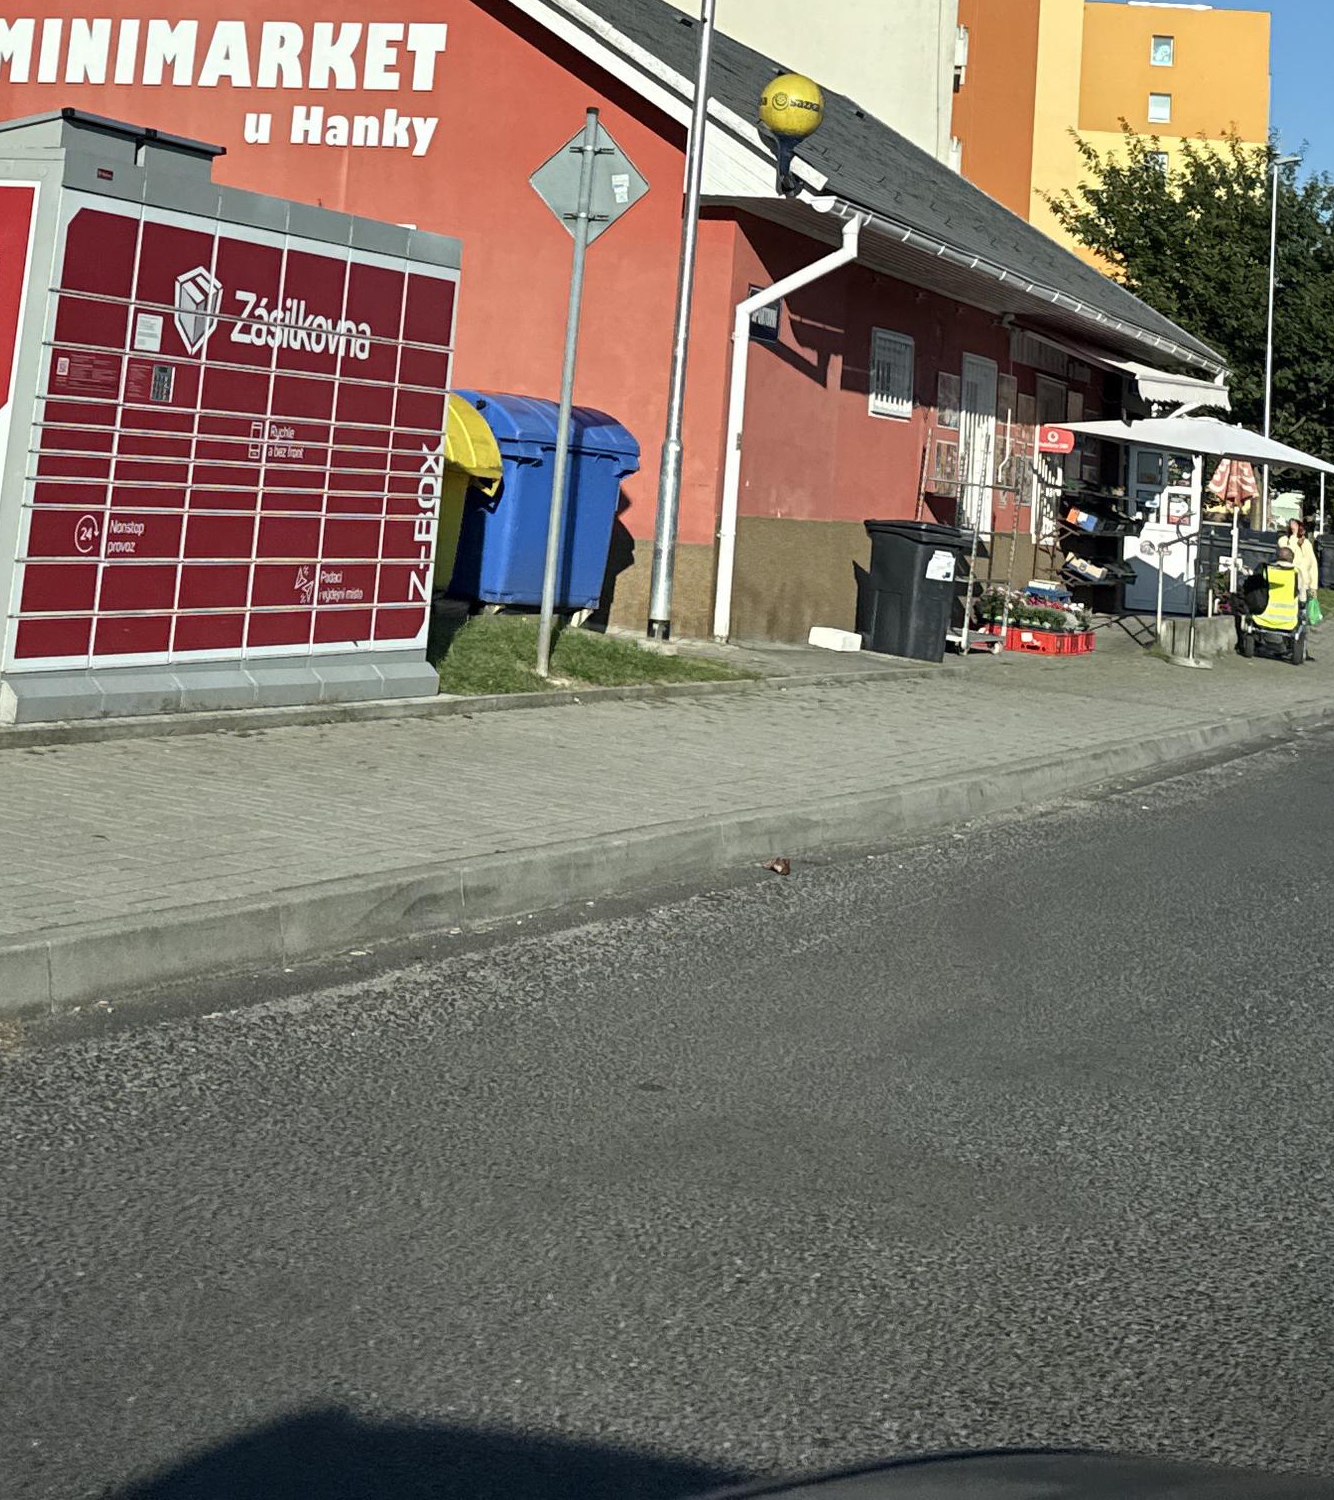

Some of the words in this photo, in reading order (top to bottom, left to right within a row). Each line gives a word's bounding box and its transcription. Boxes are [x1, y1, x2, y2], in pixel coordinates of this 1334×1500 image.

[244, 113, 272, 144] u
[290, 106, 438, 156] Hanky
[231, 290, 370, 360] Zásilkovna
[80, 527, 93, 541] 24
[110, 520, 145, 536] Nonstop
[409, 443, 444, 600] Z-BOX
[107, 541, 136, 556] provoz
